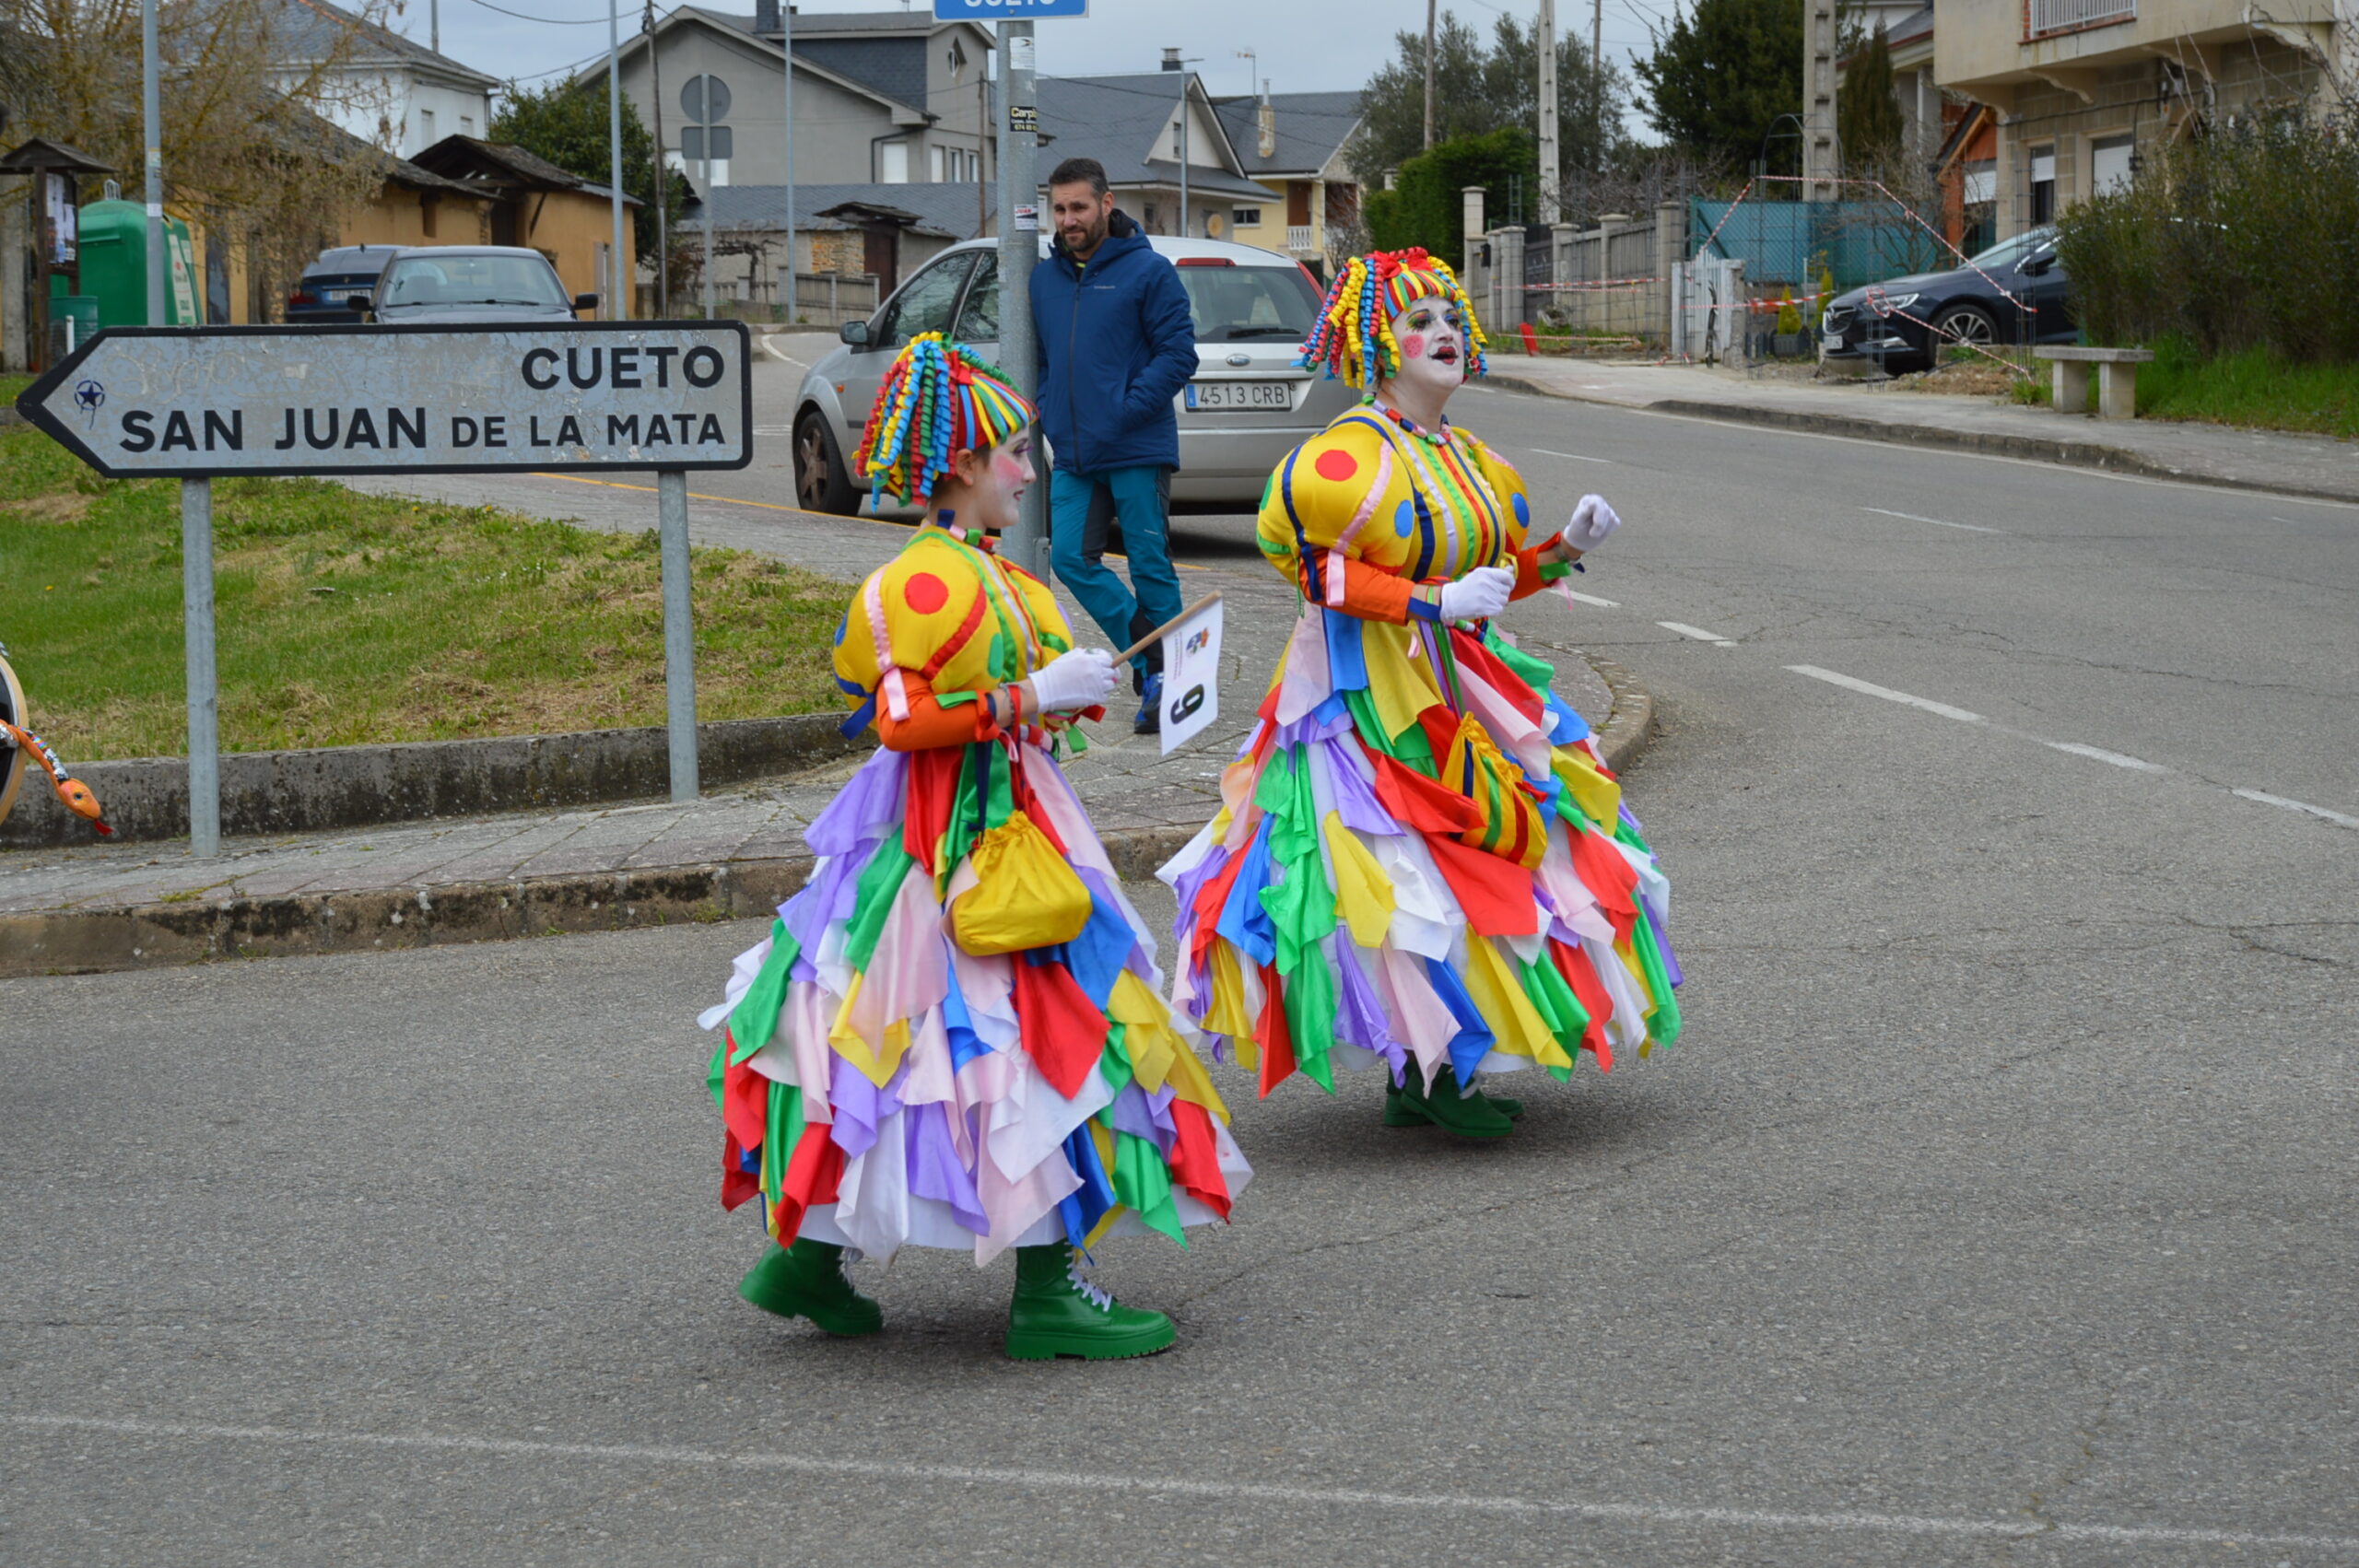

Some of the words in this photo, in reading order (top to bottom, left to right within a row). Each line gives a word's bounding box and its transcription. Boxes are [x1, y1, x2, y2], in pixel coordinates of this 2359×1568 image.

[522, 345, 724, 390] CUETO
[1200, 386, 1246, 404] 4513
[1252, 386, 1285, 404] CRB
[119, 409, 242, 452] SAN
[275, 407, 426, 450] JUAN
[452, 416, 507, 448] DE
[530, 415, 585, 446] LA
[607, 413, 725, 447] MATA
